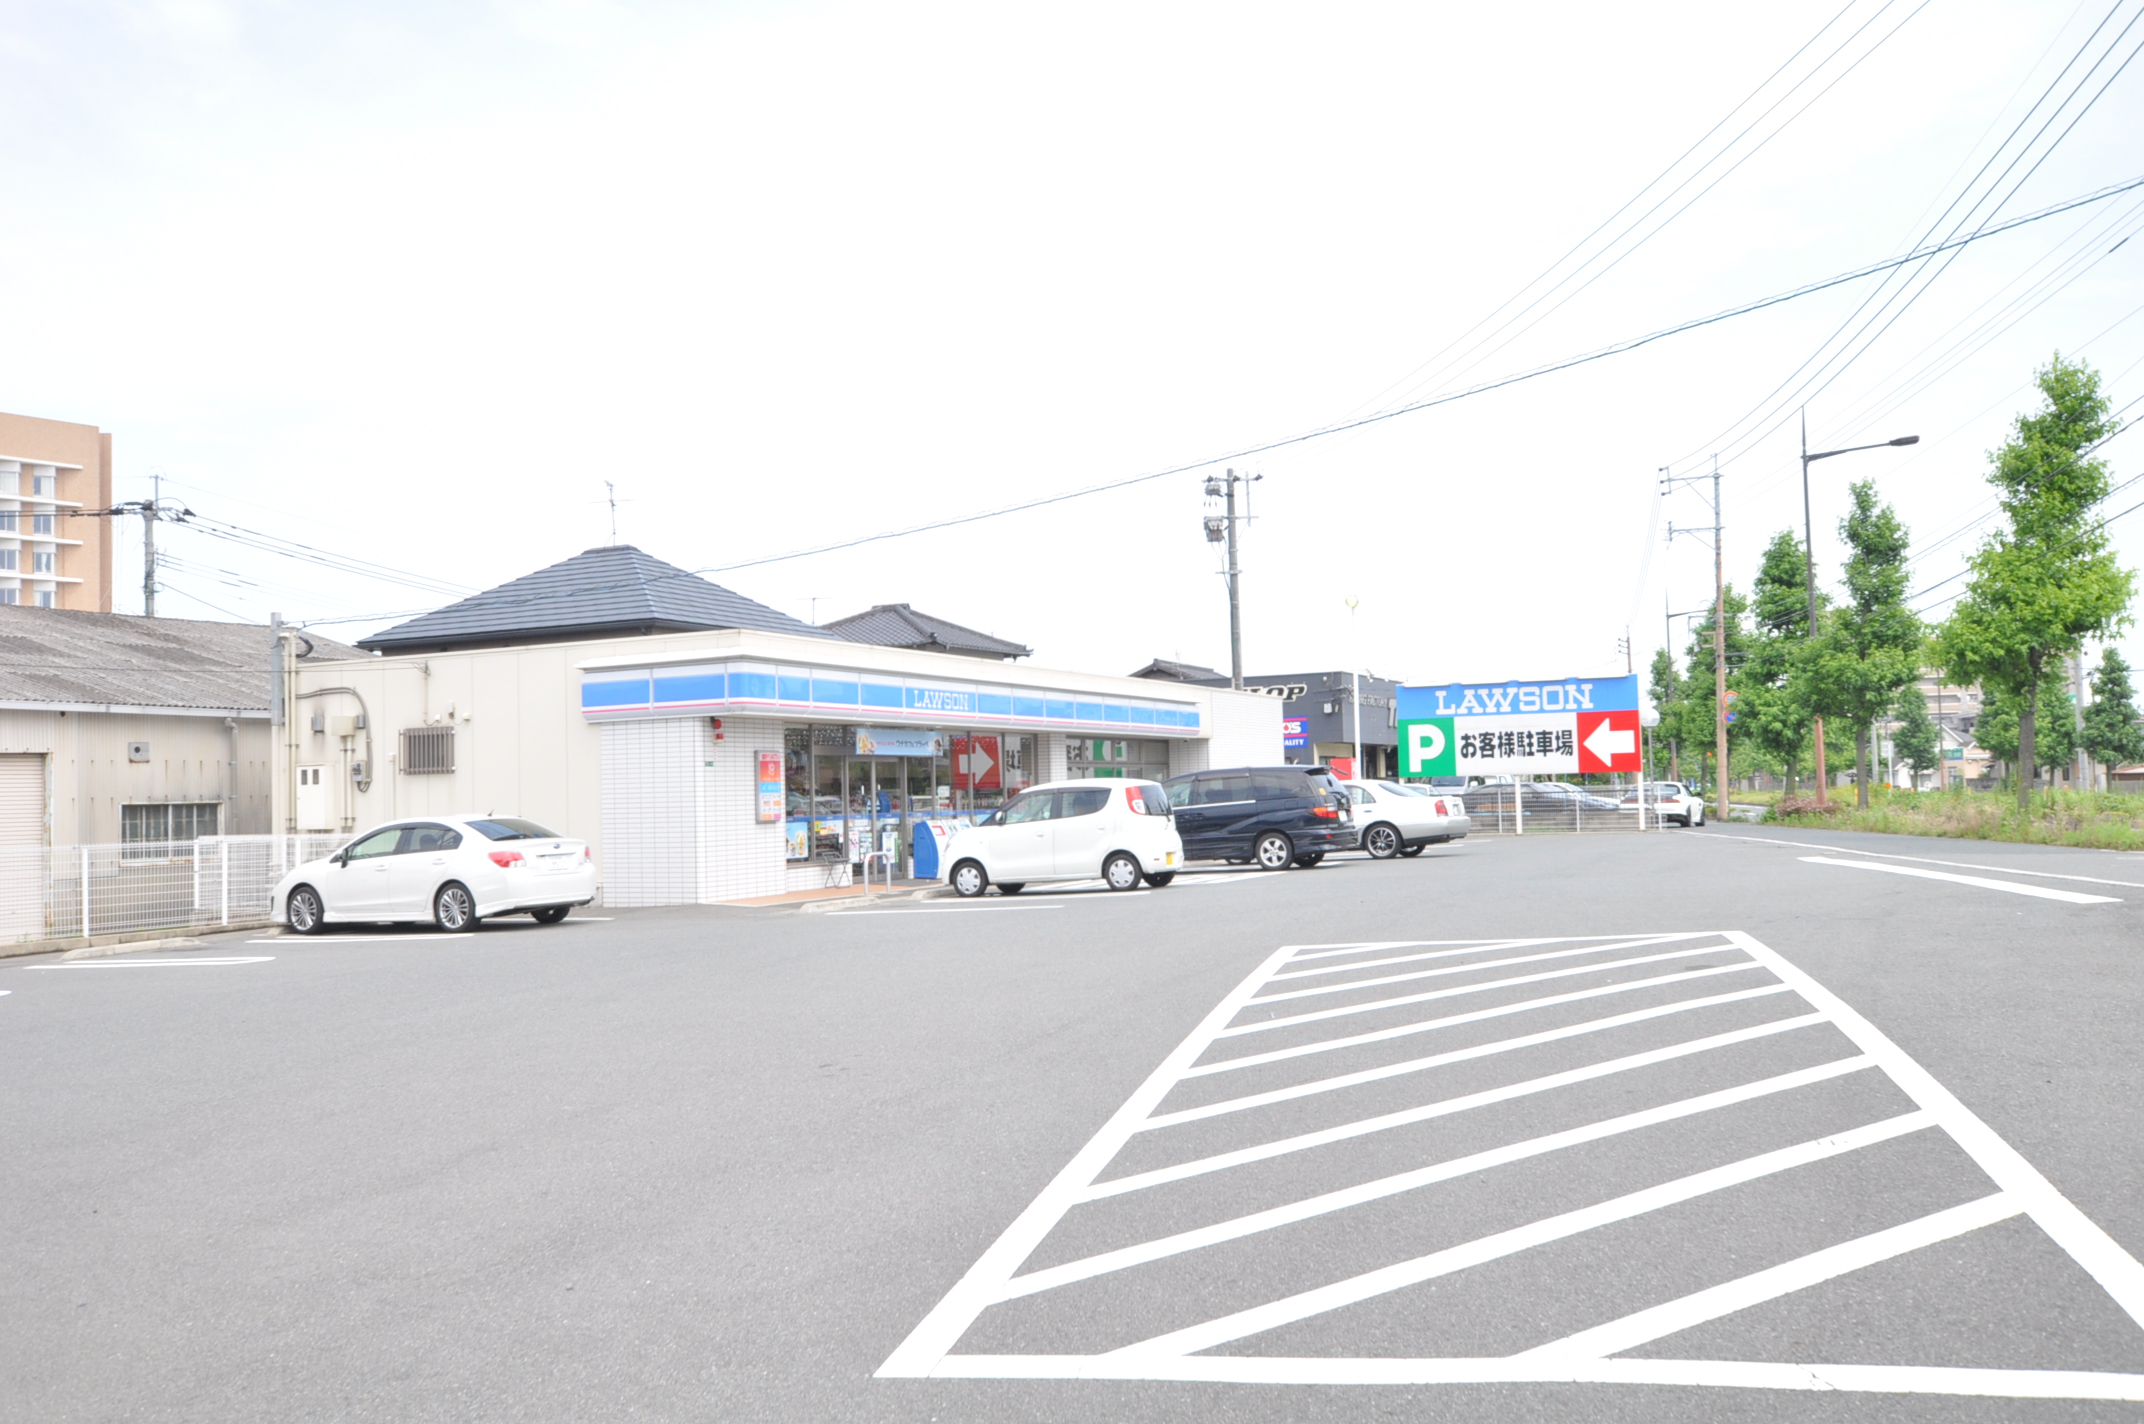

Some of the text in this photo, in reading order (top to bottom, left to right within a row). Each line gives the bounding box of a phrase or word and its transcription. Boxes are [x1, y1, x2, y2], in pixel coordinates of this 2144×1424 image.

[913, 690, 969, 710] LAWSON
[1435, 683, 1594, 715] LAWSON
[1408, 724, 1446, 773] P
[1460, 729, 1574, 759] お客様駐車場
